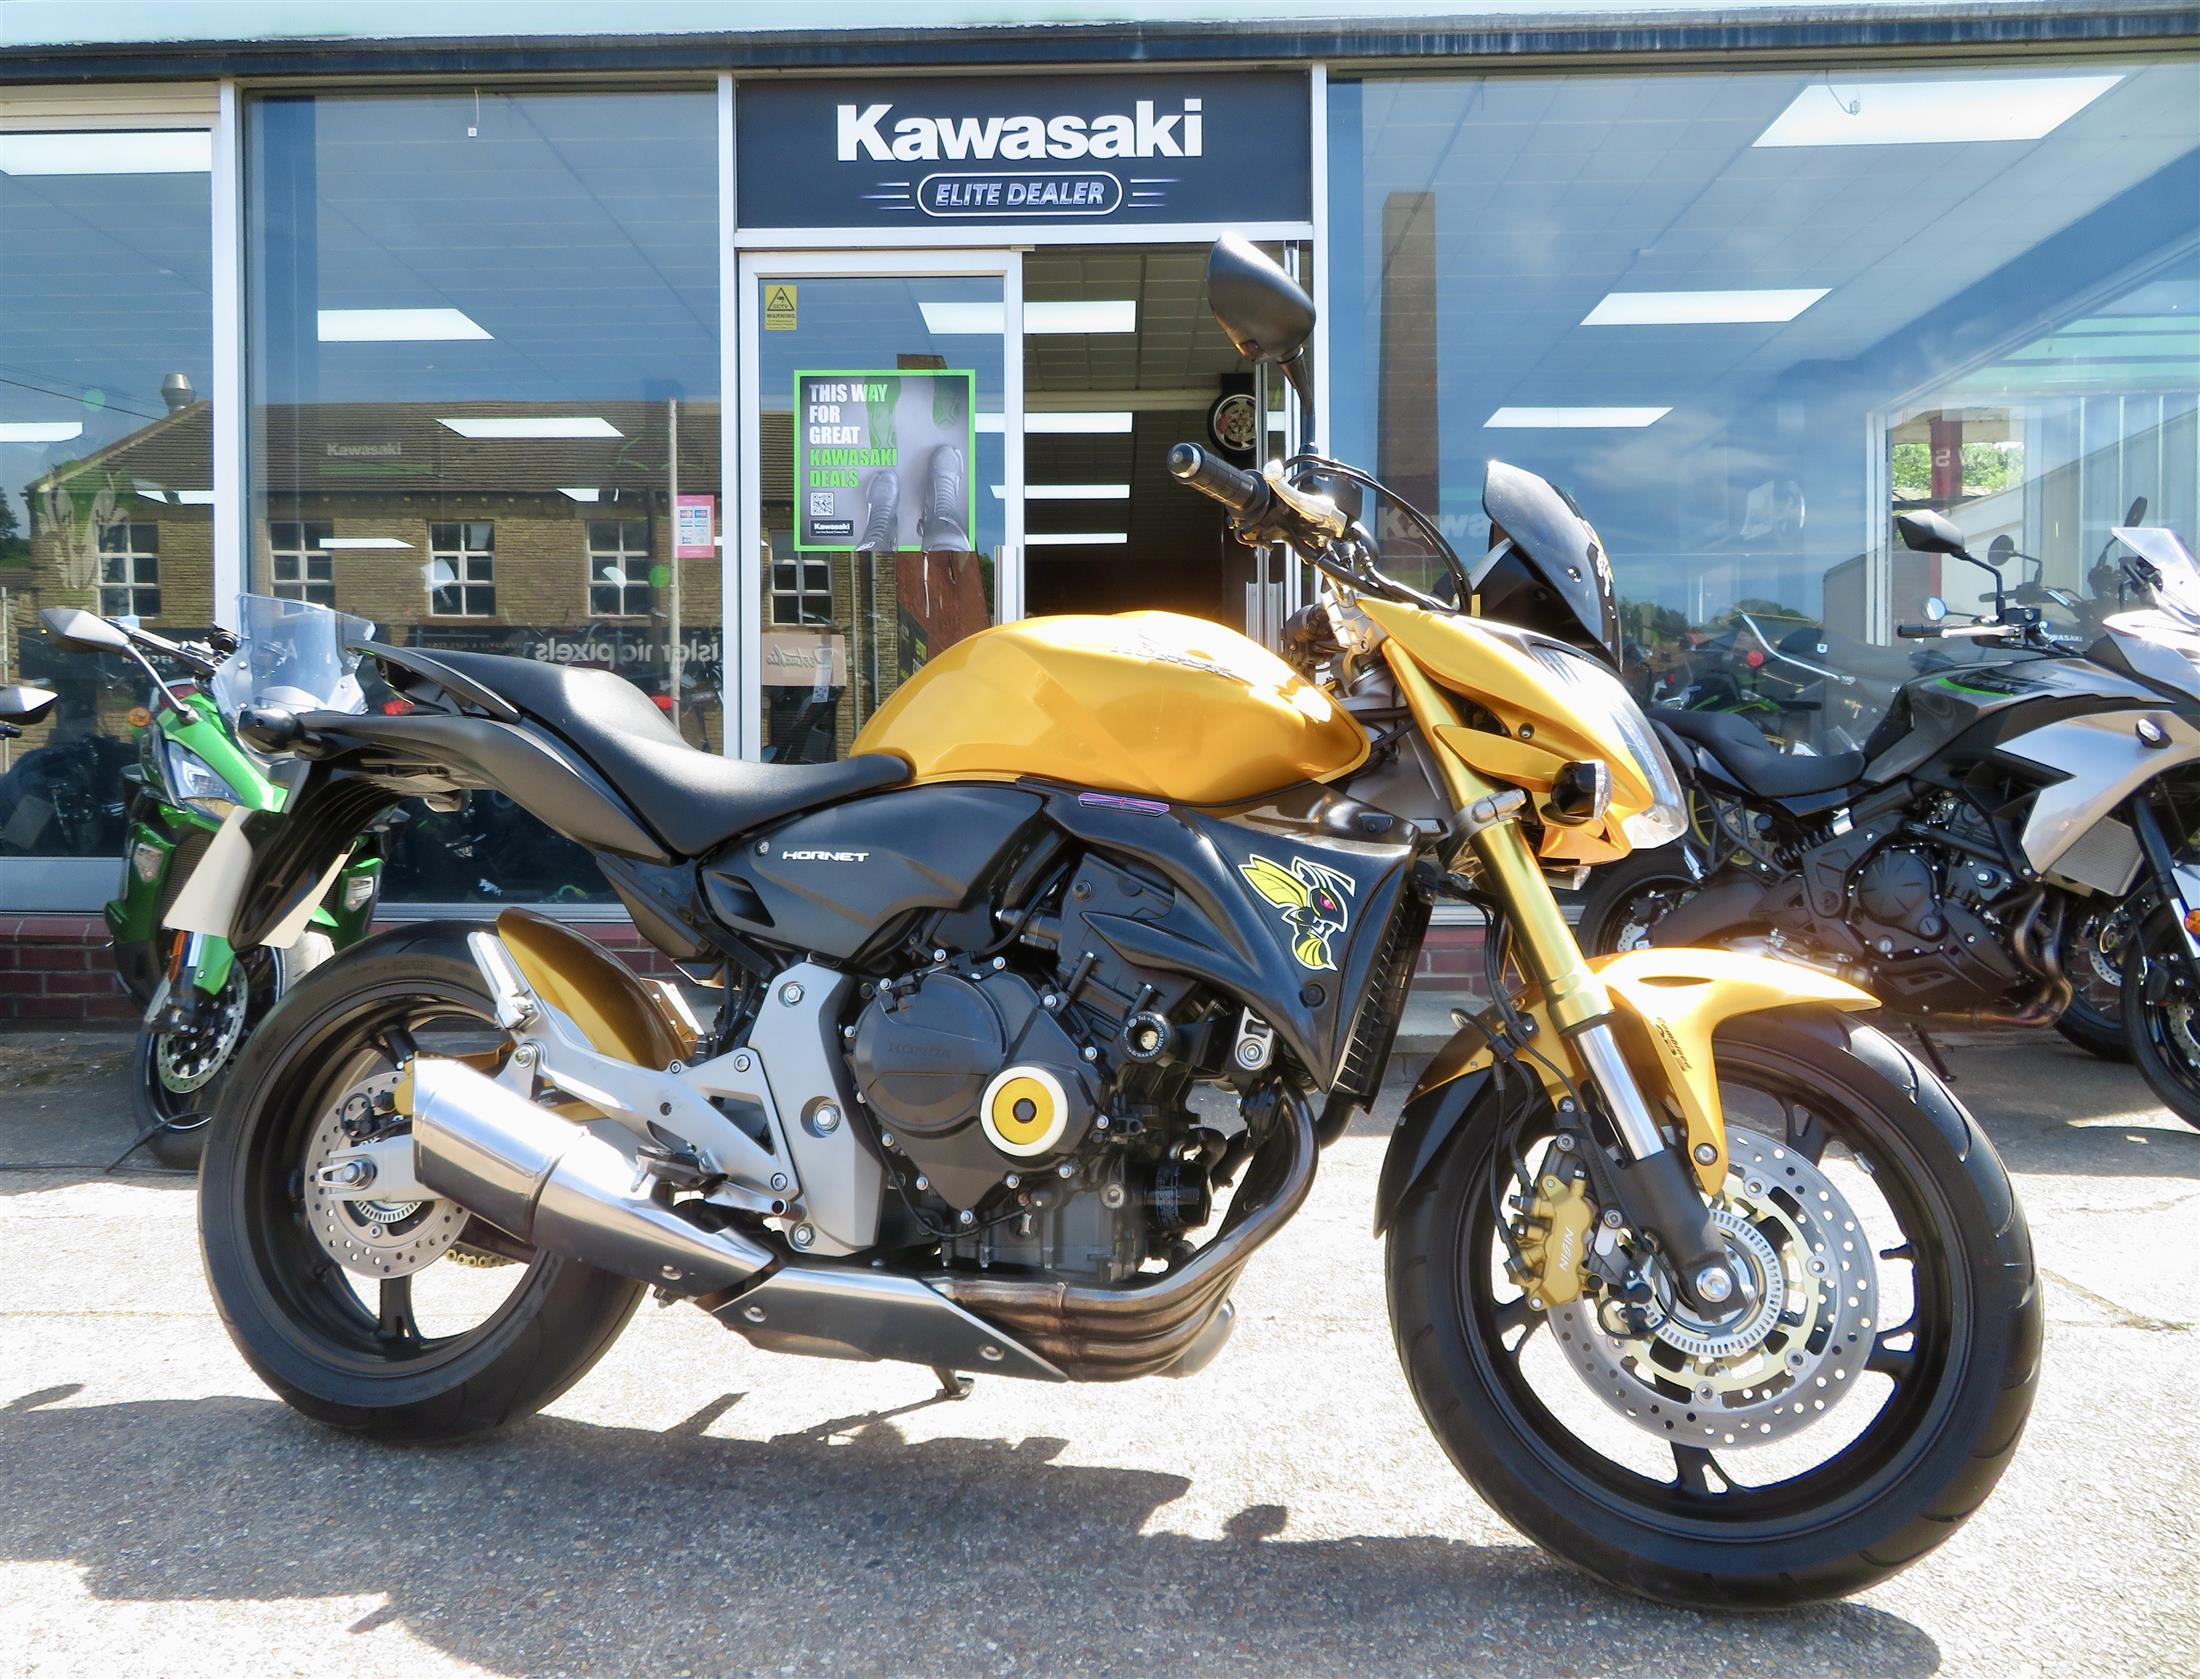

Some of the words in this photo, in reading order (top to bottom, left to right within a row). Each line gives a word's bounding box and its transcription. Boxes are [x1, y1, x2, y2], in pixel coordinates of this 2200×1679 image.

[837, 98, 1202, 162] Kawasaki
[935, 183, 1002, 206] ELITE
[1007, 181, 1105, 205] DEALER
[809, 384, 848, 402] THIS
[851, 384, 888, 402] WAY
[809, 405, 840, 423] FOR
[809, 426, 860, 444] GREAT
[327, 442, 401, 456] Kawasaki
[809, 448, 898, 466] KAWASAKI
[809, 470, 860, 488] DEALS
[1377, 506, 1492, 540] Kawa
[782, 851, 869, 862] HORNET
